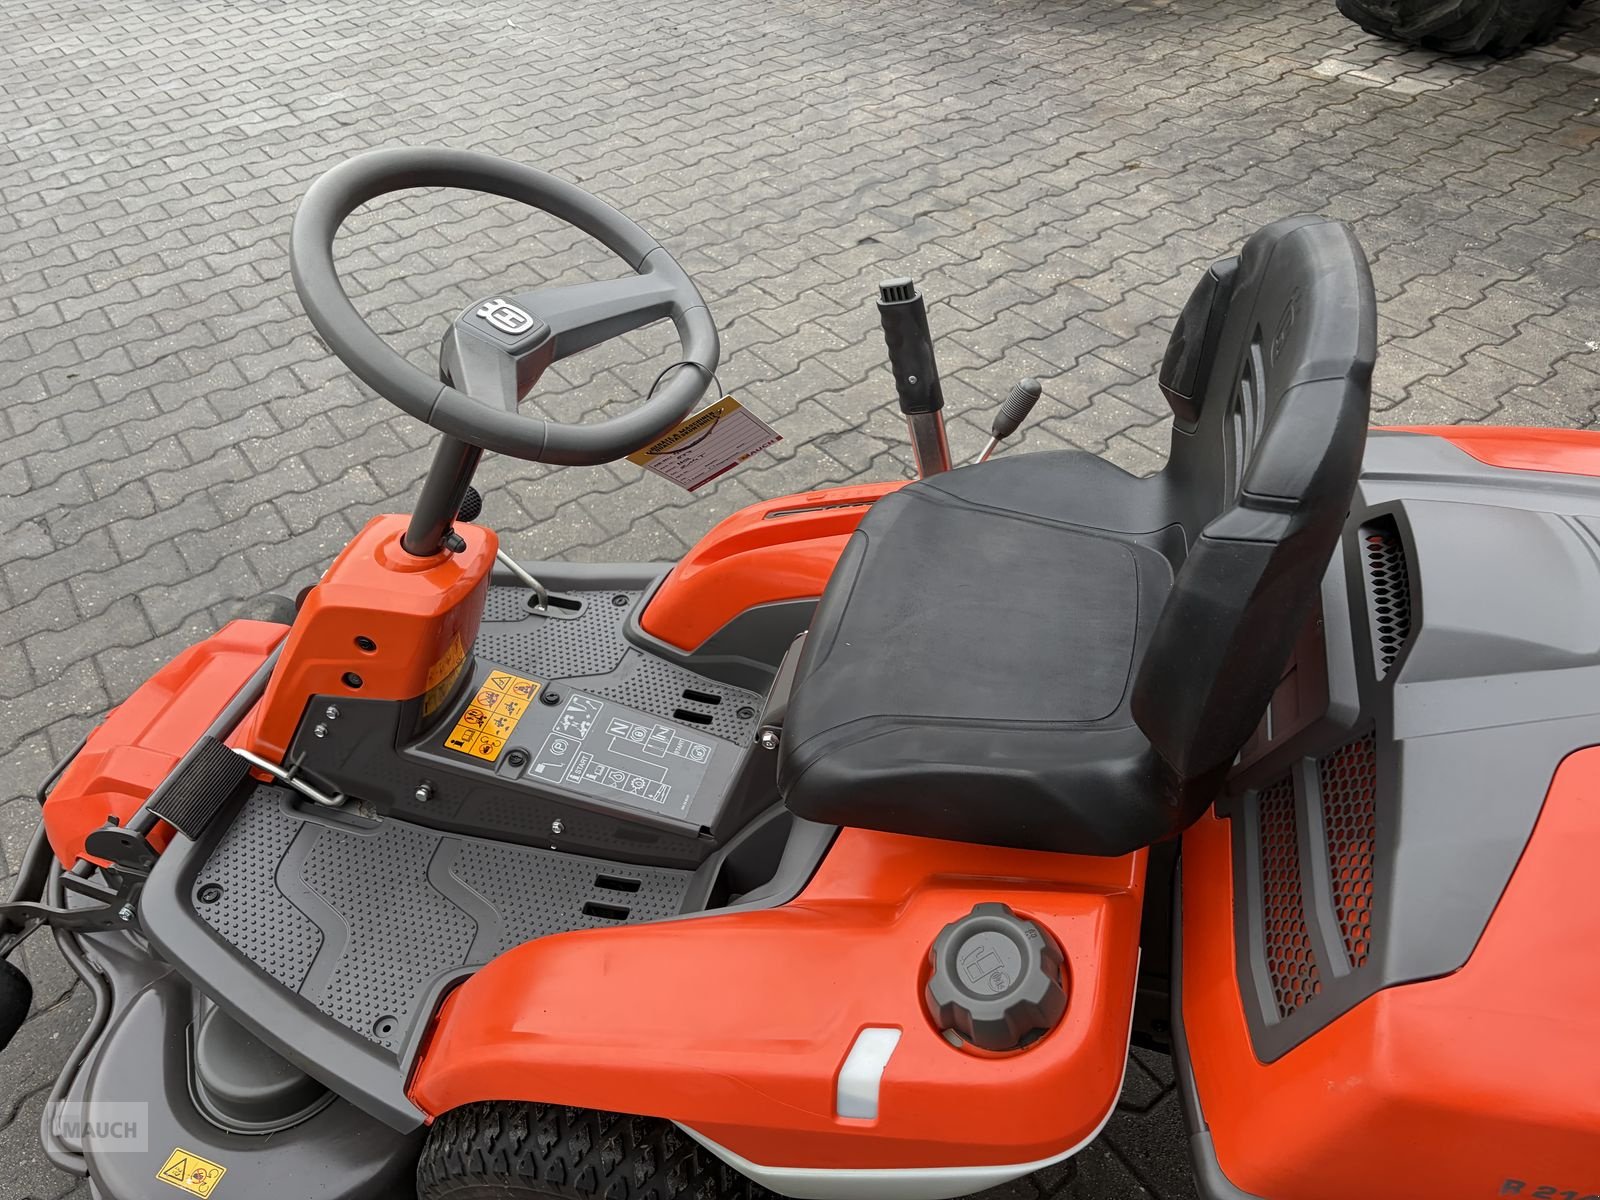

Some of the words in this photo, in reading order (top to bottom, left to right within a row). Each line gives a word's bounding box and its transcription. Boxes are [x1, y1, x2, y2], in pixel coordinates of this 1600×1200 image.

[740, 439, 775, 460] MAUCH
[610, 721, 629, 735] N
[575, 755, 589, 775] START
[1501, 1179, 1526, 1195] R
